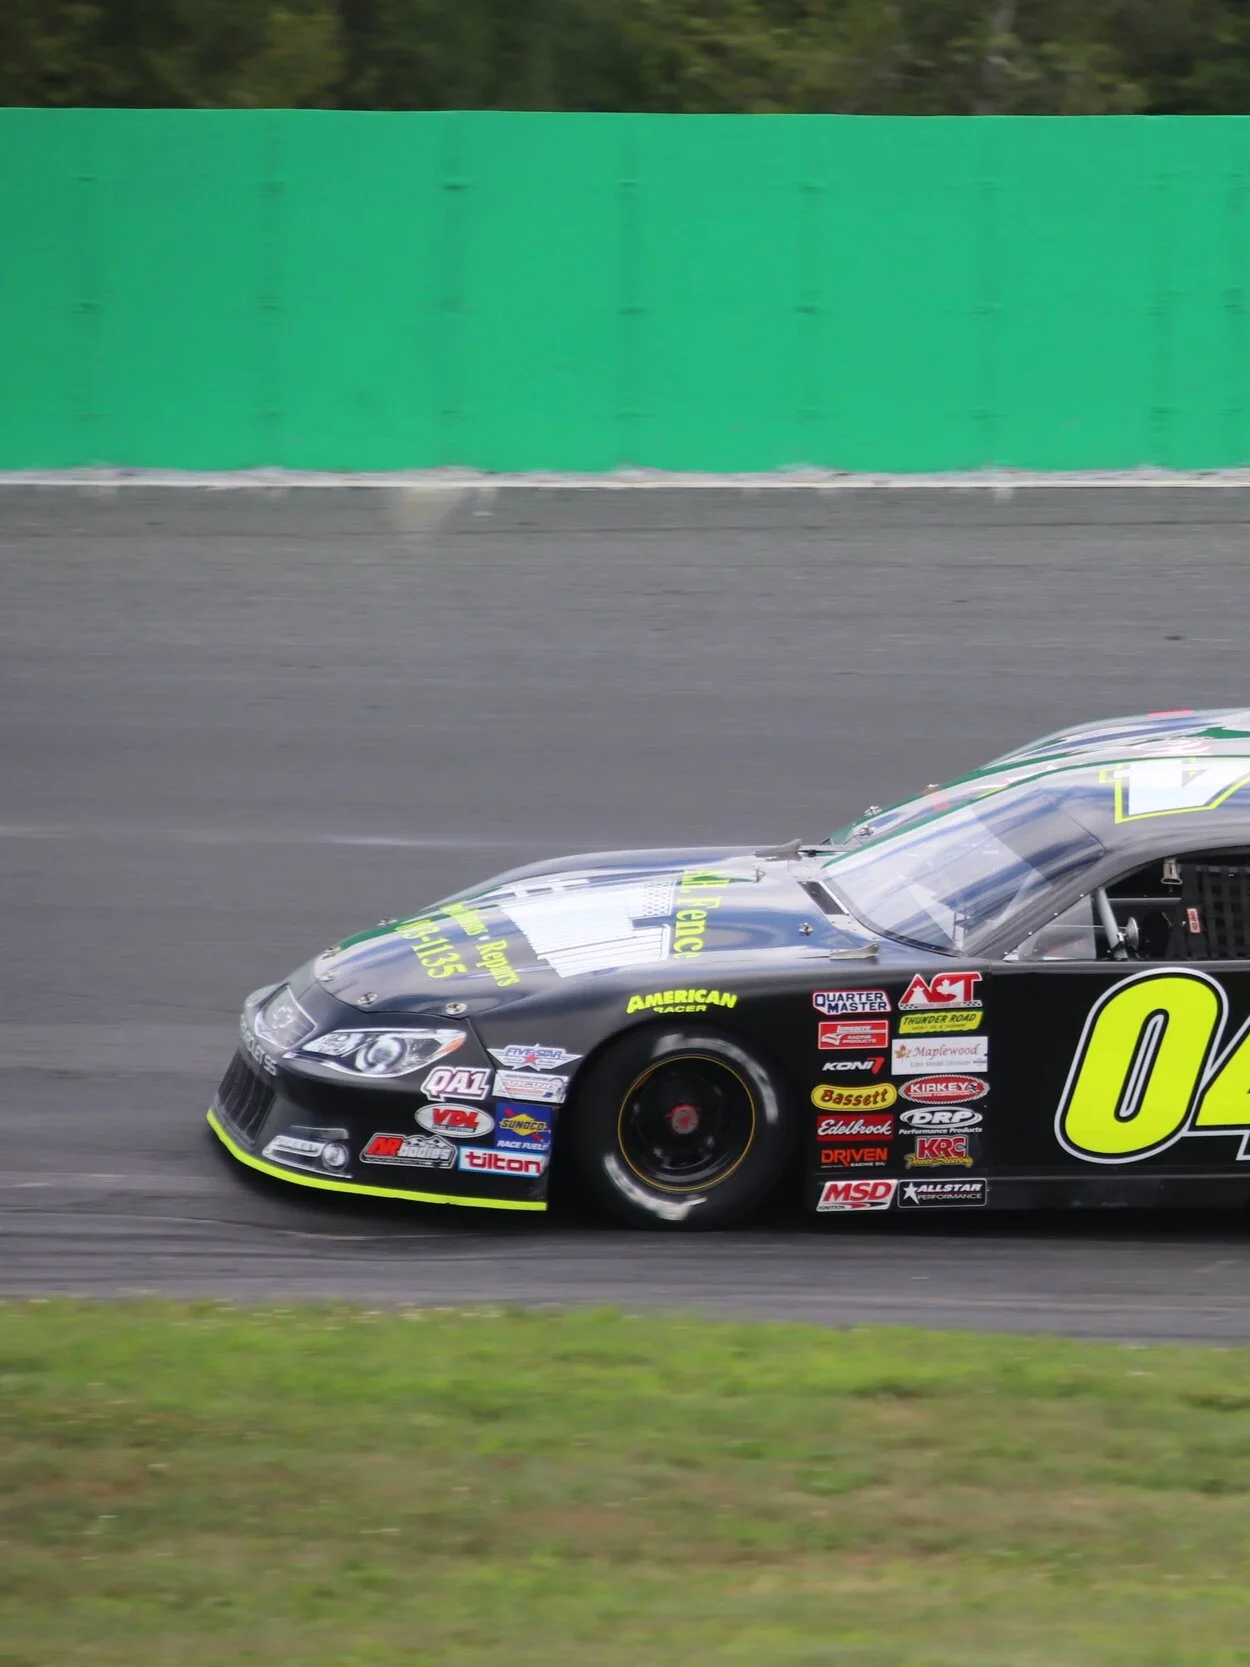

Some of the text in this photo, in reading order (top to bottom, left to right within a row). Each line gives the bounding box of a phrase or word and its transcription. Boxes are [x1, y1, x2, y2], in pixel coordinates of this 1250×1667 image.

[673, 896, 722, 959] Fence
[899, 972, 983, 1004] ACT
[626, 989, 738, 1014] AMERICAN
[815, 992, 884, 1007] QUARTER
[653, 1004, 708, 1014] RACER
[827, 1002, 887, 1014] MASTER
[902, 1013, 977, 1026] THUNDER ROAD
[912, 1043, 981, 1060] Maplewood
[822, 1060, 875, 1071] KONI
[424, 1068, 488, 1097] QA1
[910, 1082, 969, 1093] KIRKEY
[820, 1088, 888, 1107] Bassett
[432, 1108, 479, 1129] VDL
[501, 1118, 545, 1131] SUNOCO
[911, 1111, 973, 1125] DRP
[817, 1119, 892, 1136] Edelbrock
[949, 1126, 983, 1134] Products
[496, 1139, 521, 1149] RACE
[916, 1135, 966, 1160] KRC
[465, 1151, 543, 1174] tilton
[821, 1147, 888, 1167] DRIVEN
[823, 1182, 892, 1202] MSD
[917, 1183, 984, 1193] ALLSTAR
[917, 1193, 983, 1201] PERFORMANCE
